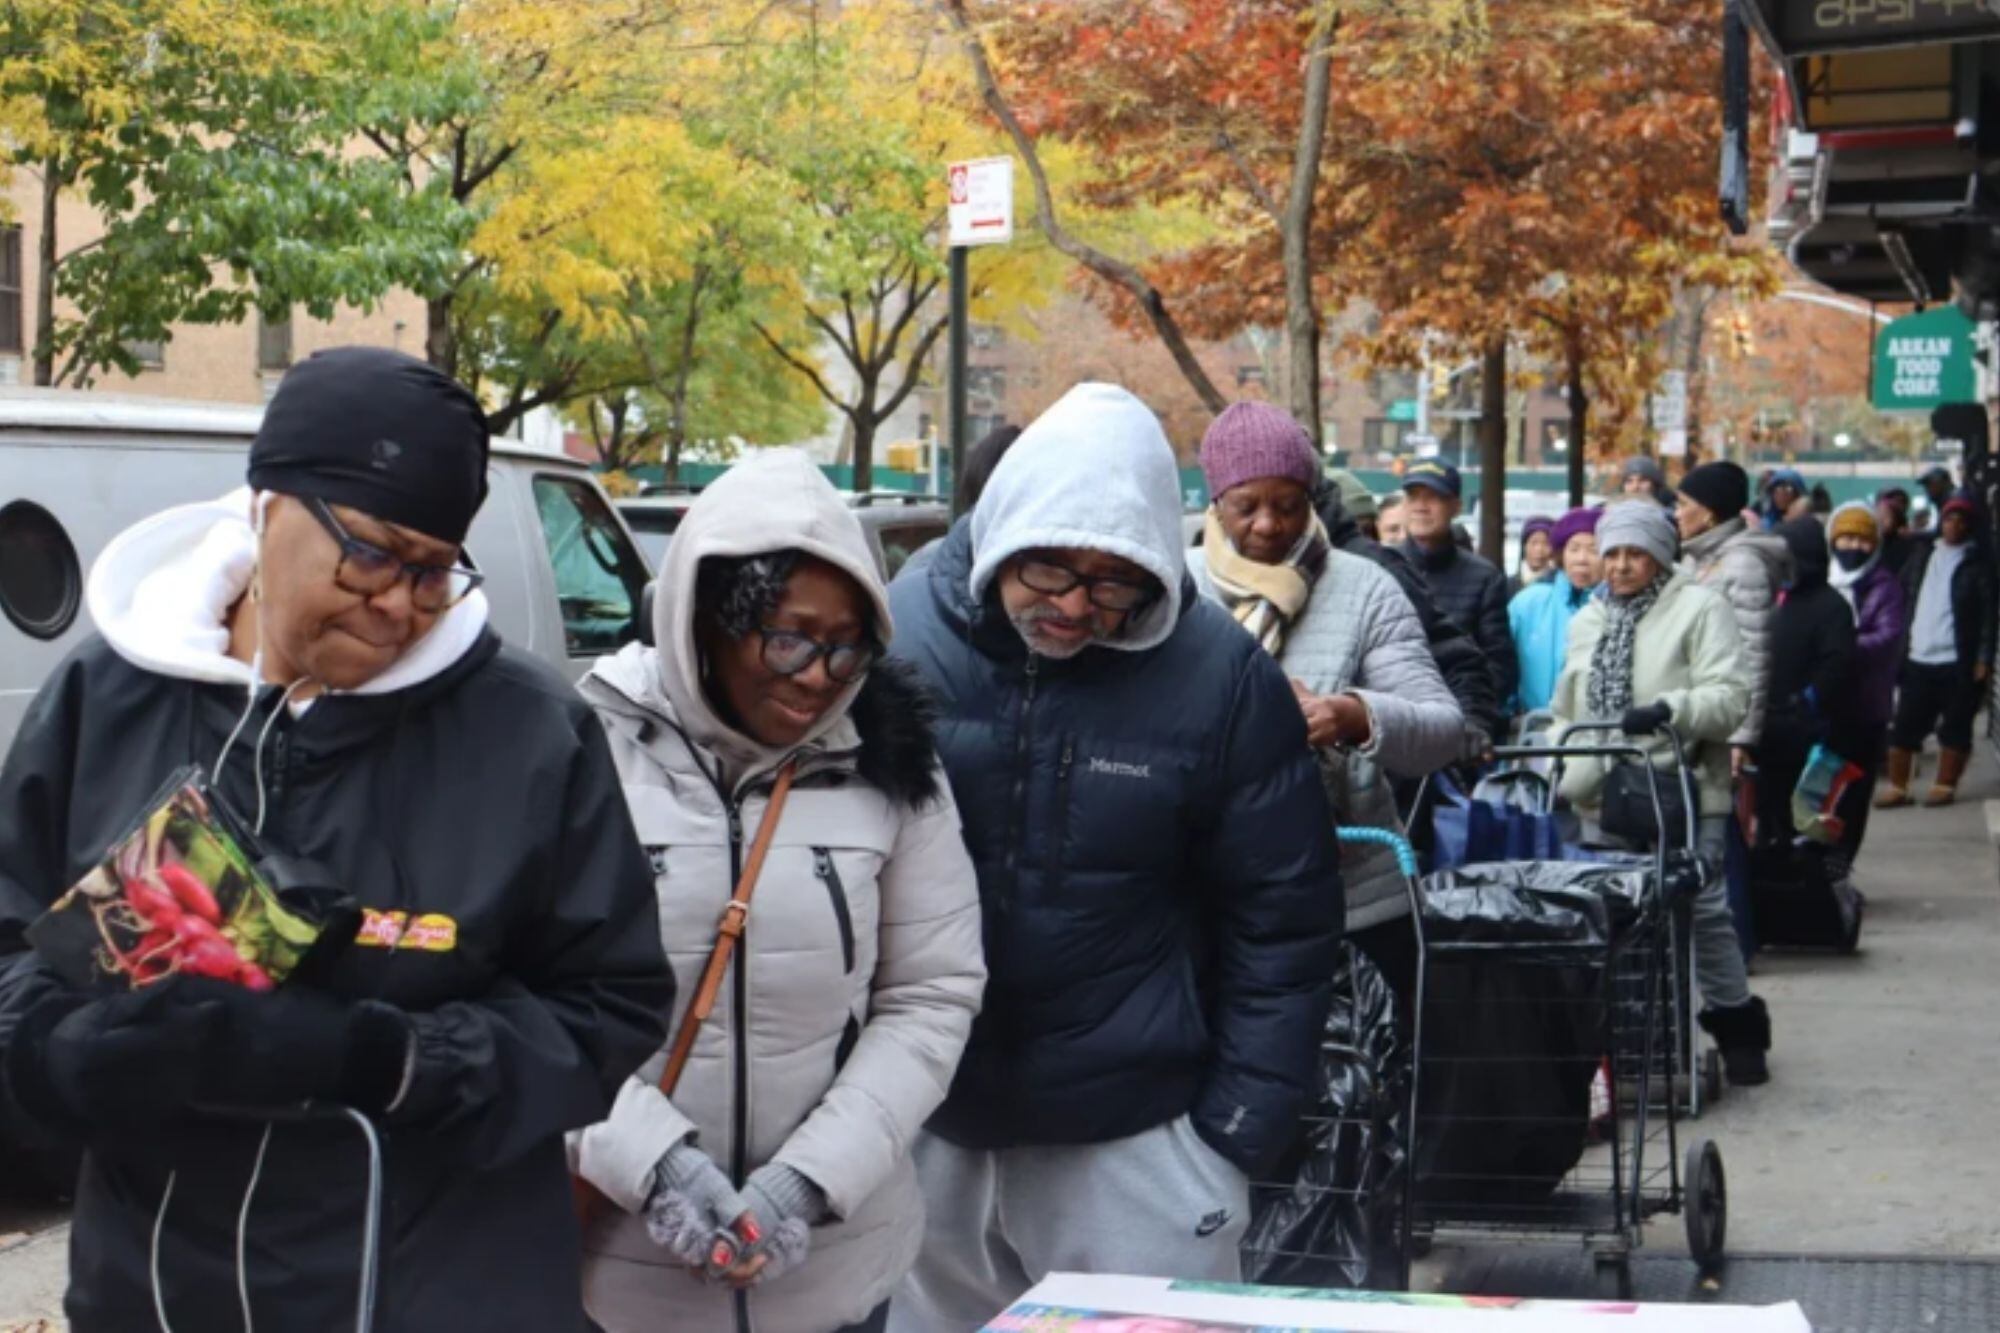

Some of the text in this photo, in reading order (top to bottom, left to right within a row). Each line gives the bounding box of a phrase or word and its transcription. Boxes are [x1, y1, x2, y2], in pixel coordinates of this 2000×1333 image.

[1886, 337, 1951, 356] ARKAN
[1895, 357, 1942, 376] FOOD
[1892, 377, 1940, 396] CORP.
[1090, 757, 1150, 778] Marmot
